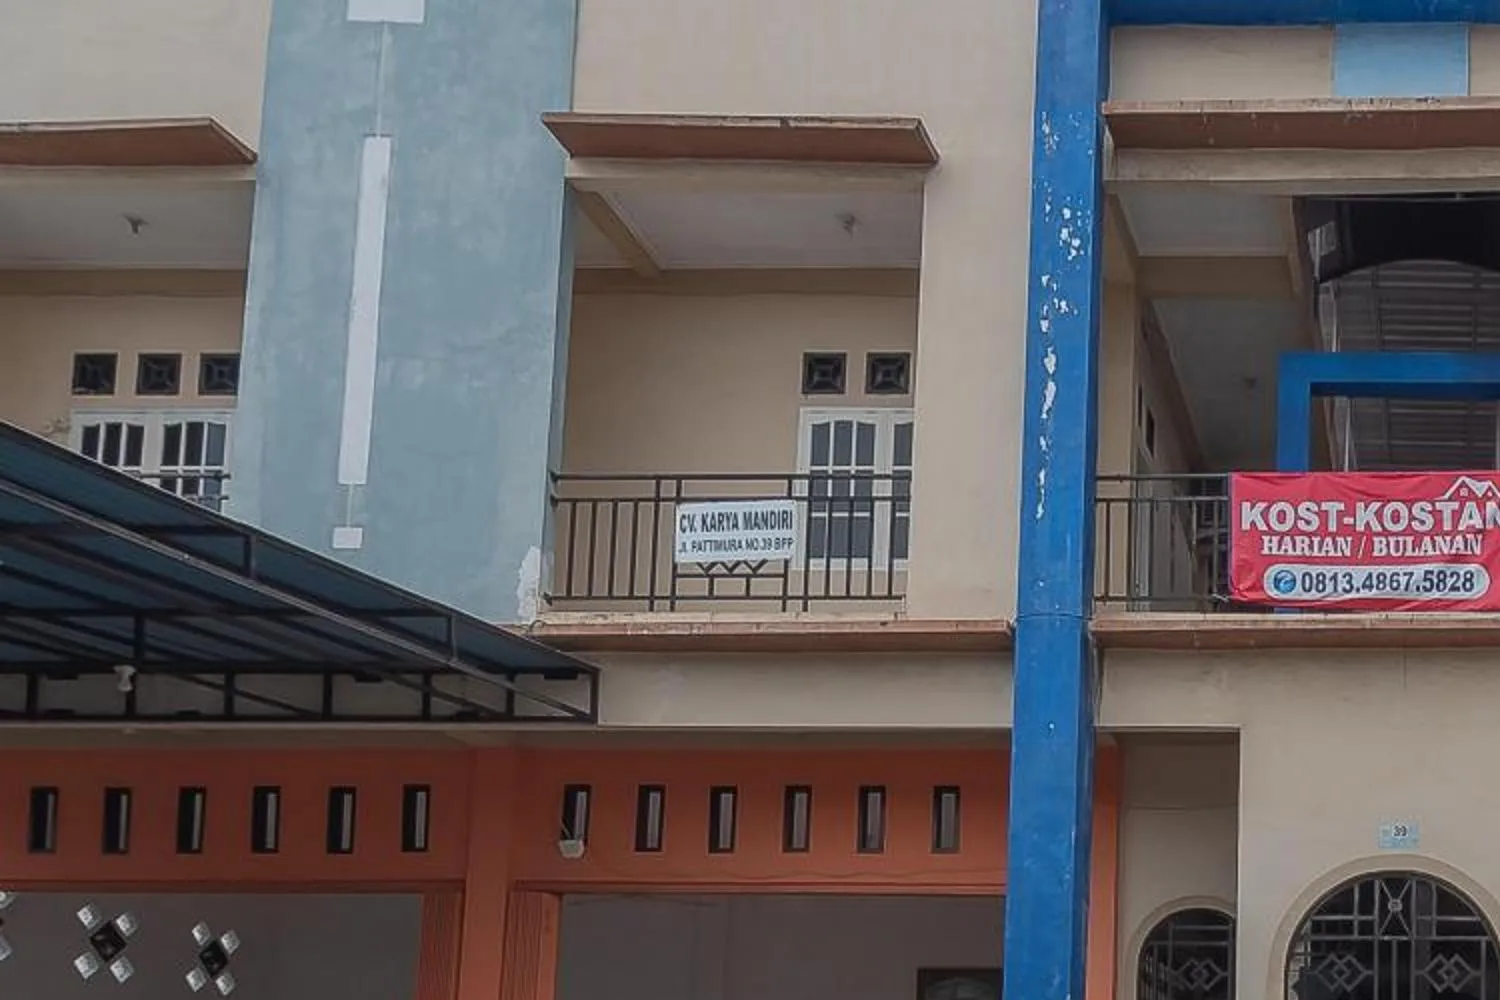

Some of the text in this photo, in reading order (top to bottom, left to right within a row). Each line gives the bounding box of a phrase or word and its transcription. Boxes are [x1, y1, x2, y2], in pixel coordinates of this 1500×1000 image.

[701, 511, 739, 532] KARYA
[743, 509, 793, 531] MANDIRI
[1261, 535, 1353, 557] HARIAN
[1372, 534, 1483, 557] BULANAN
[1300, 569, 1475, 594] 0813.4867.5828
